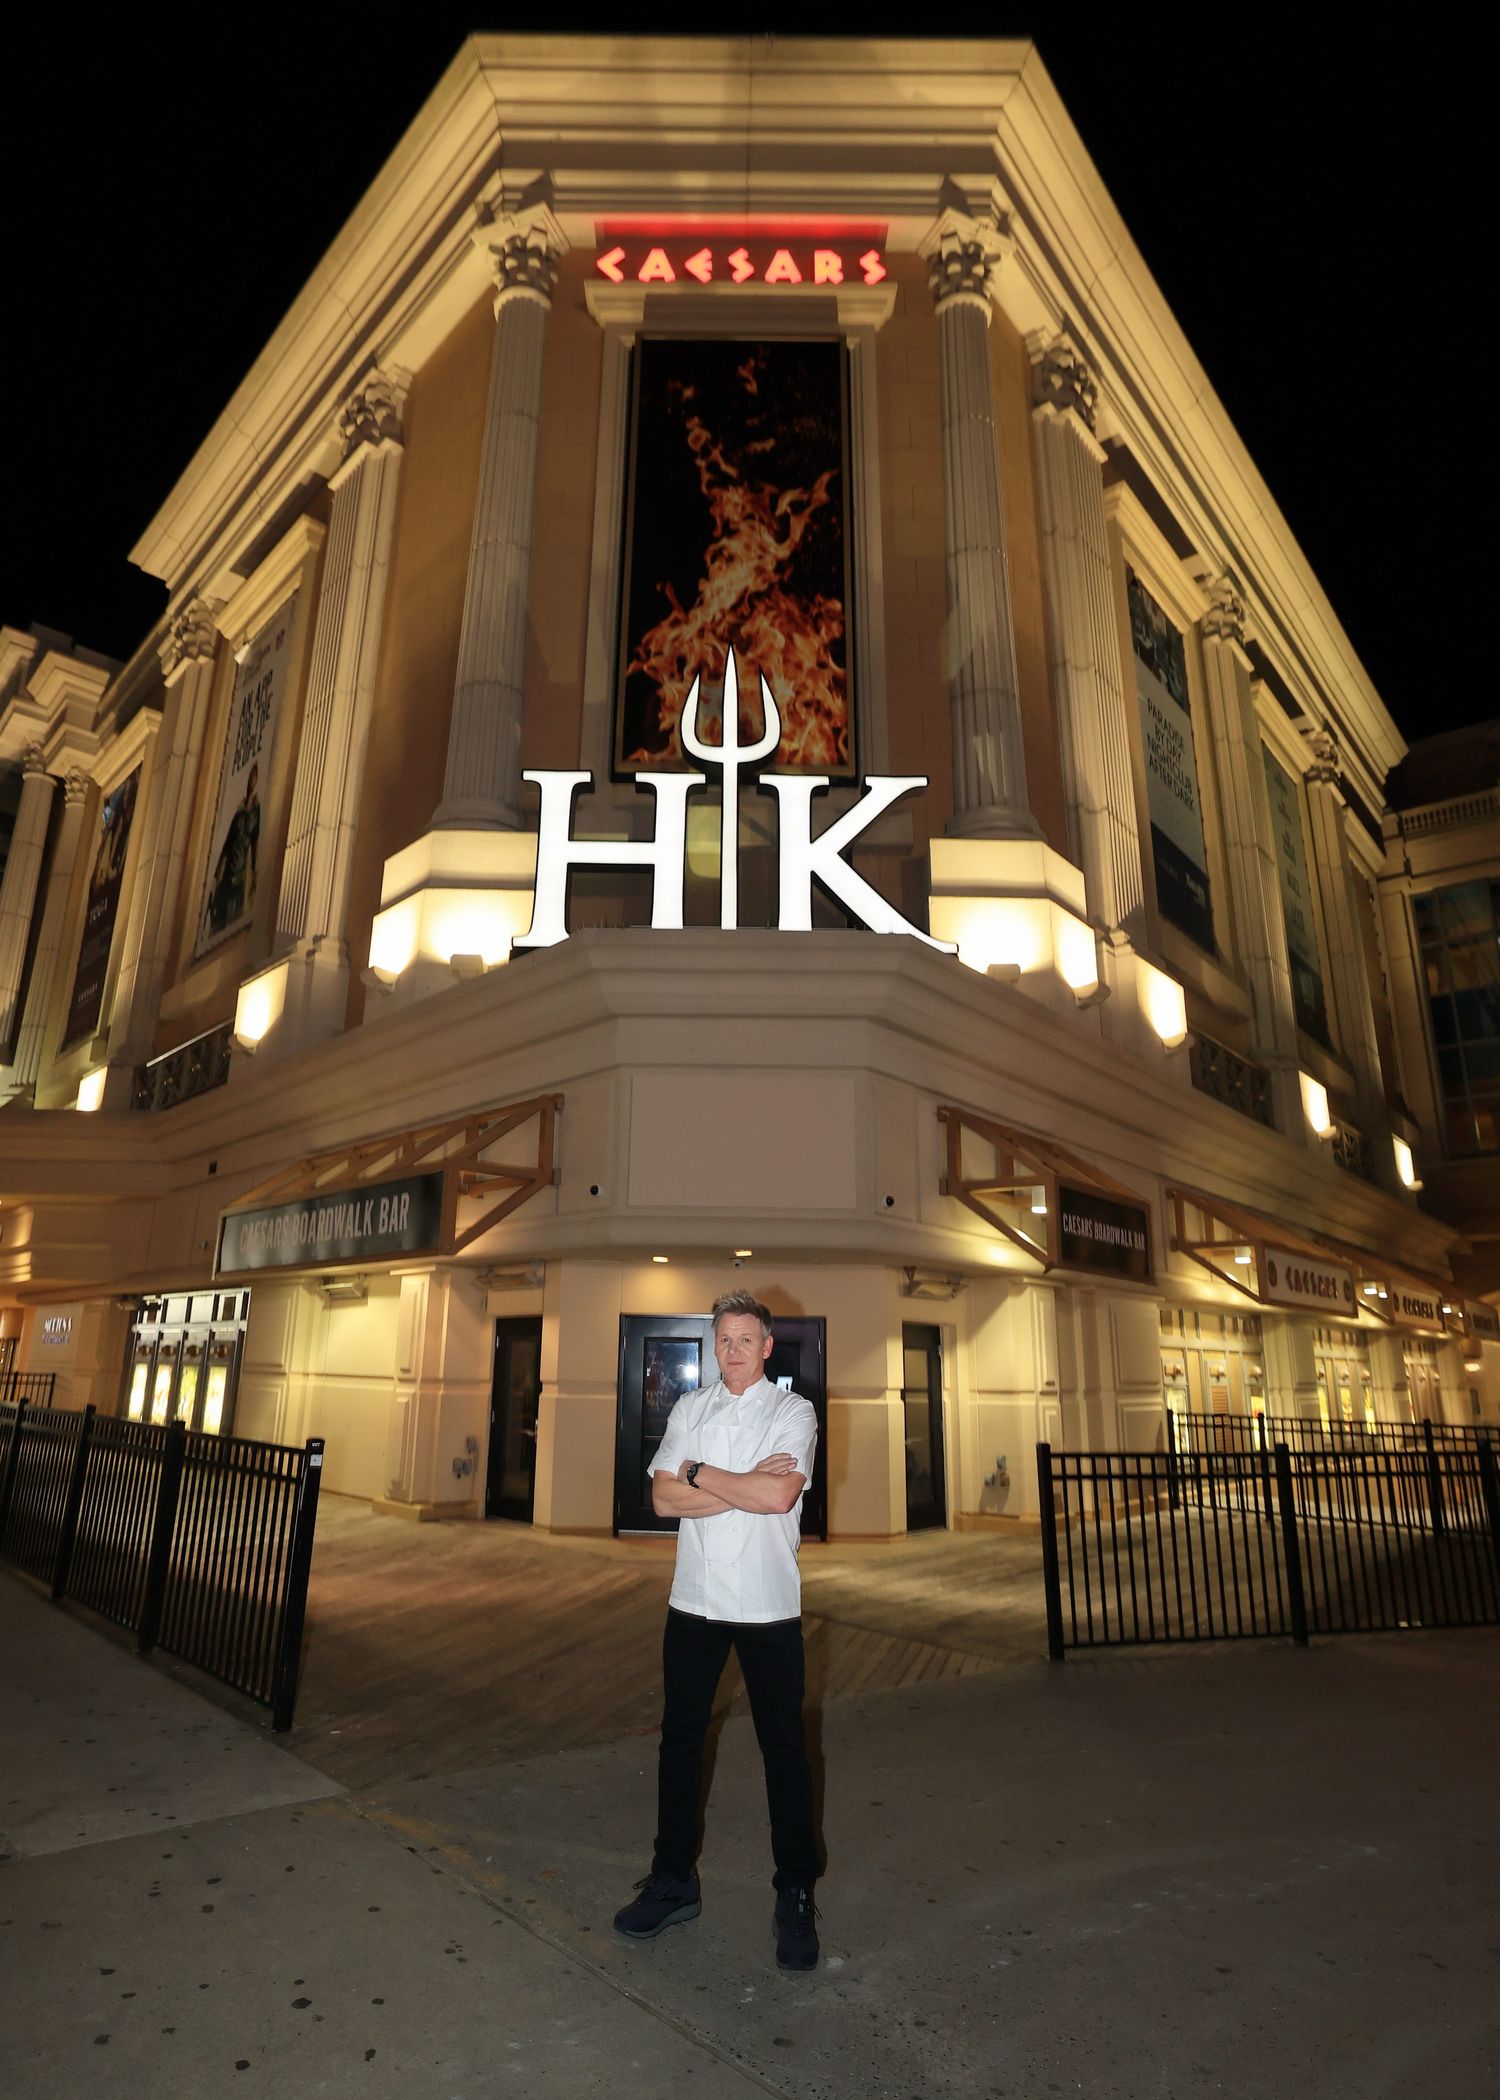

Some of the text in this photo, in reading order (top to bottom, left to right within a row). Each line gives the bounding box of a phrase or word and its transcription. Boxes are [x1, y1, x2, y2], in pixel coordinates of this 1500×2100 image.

[596, 247, 886, 285] CAESARS
[1147, 698, 1185, 755] PARADISE
[1155, 721, 1181, 765] BY DAY
[1147, 732, 1193, 794] NIGHTCLUB
[240, 1192, 410, 1252] CAESARS BOARDWALK BAR
[1063, 1213, 1145, 1251] CAESARS BOARDWALK BAR
[1286, 1265, 1338, 1299] CAESARS
